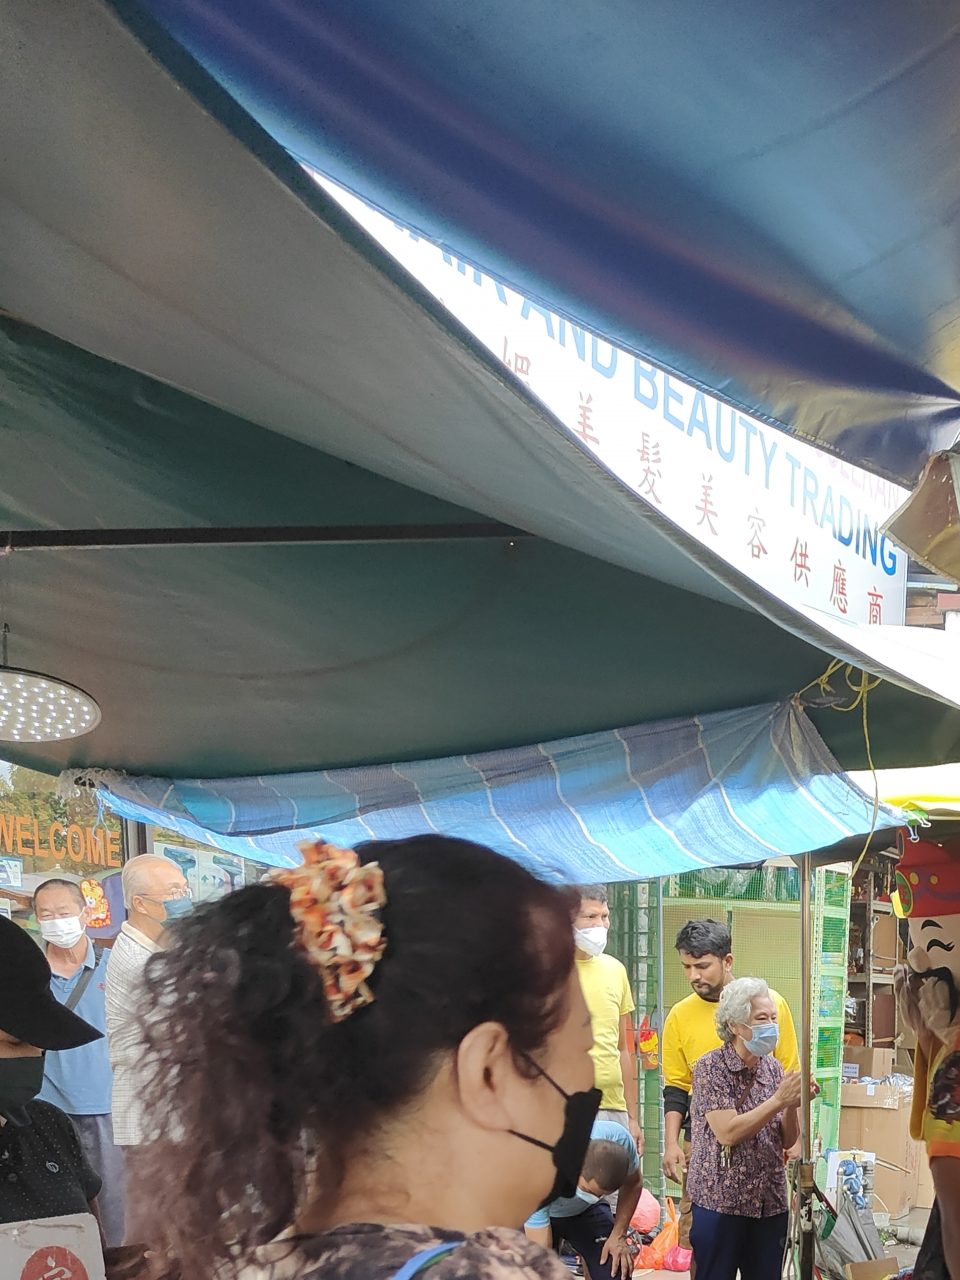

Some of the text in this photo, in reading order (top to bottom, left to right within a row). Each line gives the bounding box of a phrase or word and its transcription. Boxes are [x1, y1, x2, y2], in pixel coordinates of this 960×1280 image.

[521, 298, 618, 379] AND
[634, 358, 778, 490] BEAUTY
[785, 451, 898, 577] TRADING
